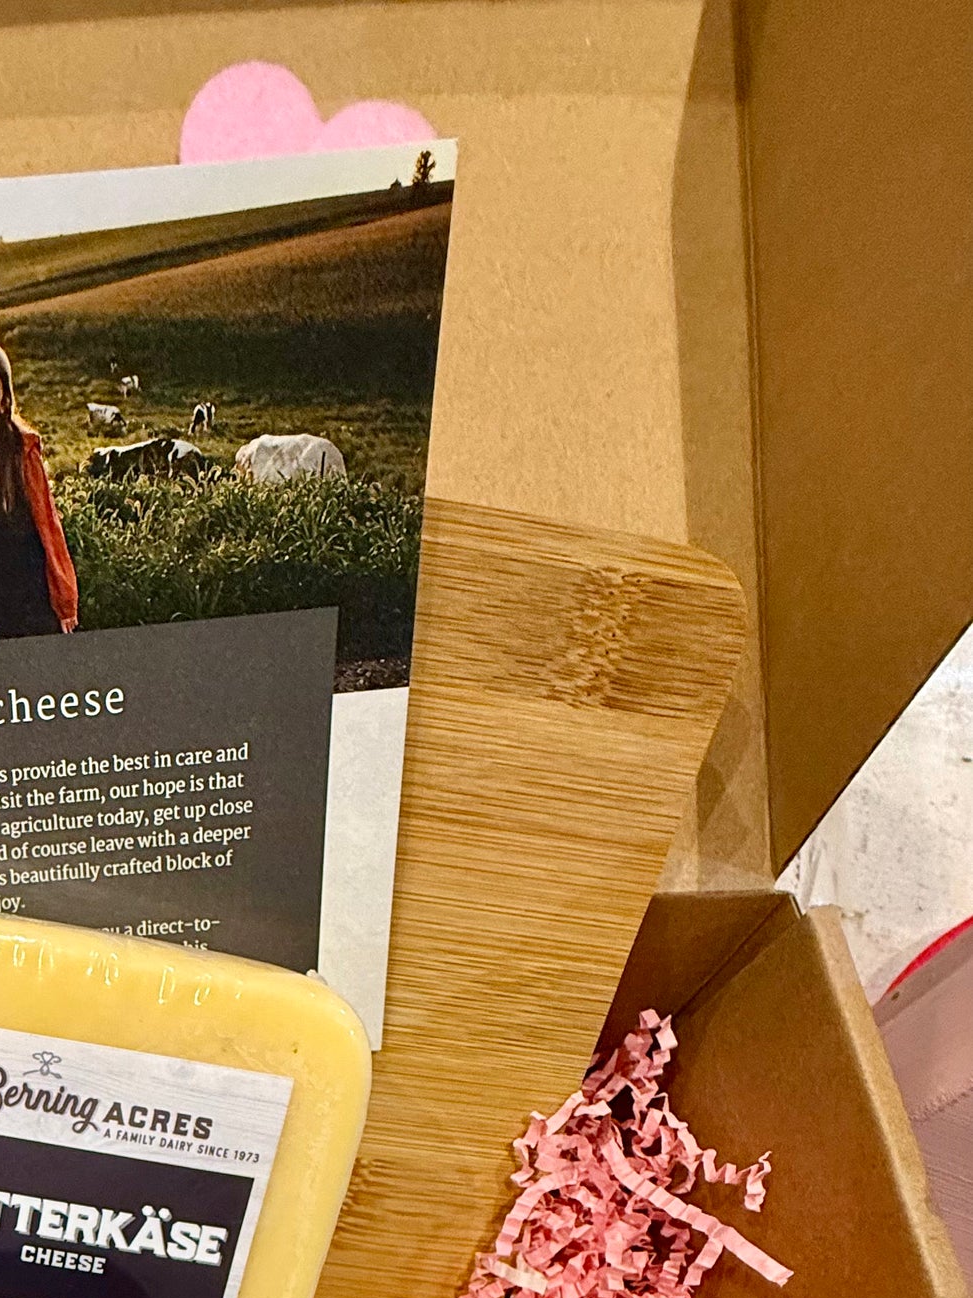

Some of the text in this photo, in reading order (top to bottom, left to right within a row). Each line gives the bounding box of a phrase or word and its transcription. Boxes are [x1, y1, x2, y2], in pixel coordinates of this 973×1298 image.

[11, 759, 77, 787] provide
[80, 756, 110, 776] the
[112, 754, 151, 772] best
[154, 750, 172, 769] in
[175, 750, 213, 767] care
[215, 742, 249, 763] and
[26, 788, 55, 807] the
[58, 785, 106, 805] farm,
[109, 783, 140, 800] our
[142, 778, 186, 799] hope
[189, 774, 205, 792] is
[208, 771, 244, 790] that
[0, 813, 94, 839] agriculture
[97, 807, 150, 828] today,
[153, 804, 181, 826] get
[184, 804, 206, 823] up
[209, 798, 253, 817] close
[9, 862, 101, 885] beautifully
[102, 855, 162, 877] crafted
[165, 851, 212, 872] block
[214, 848, 234, 867] of
[103, 1102, 213, 1140] ACRES
[103, 1128, 260, 1164] A FAMILY DAIRY SINCE 1973
[20, 1245, 107, 1275] CHEESE
